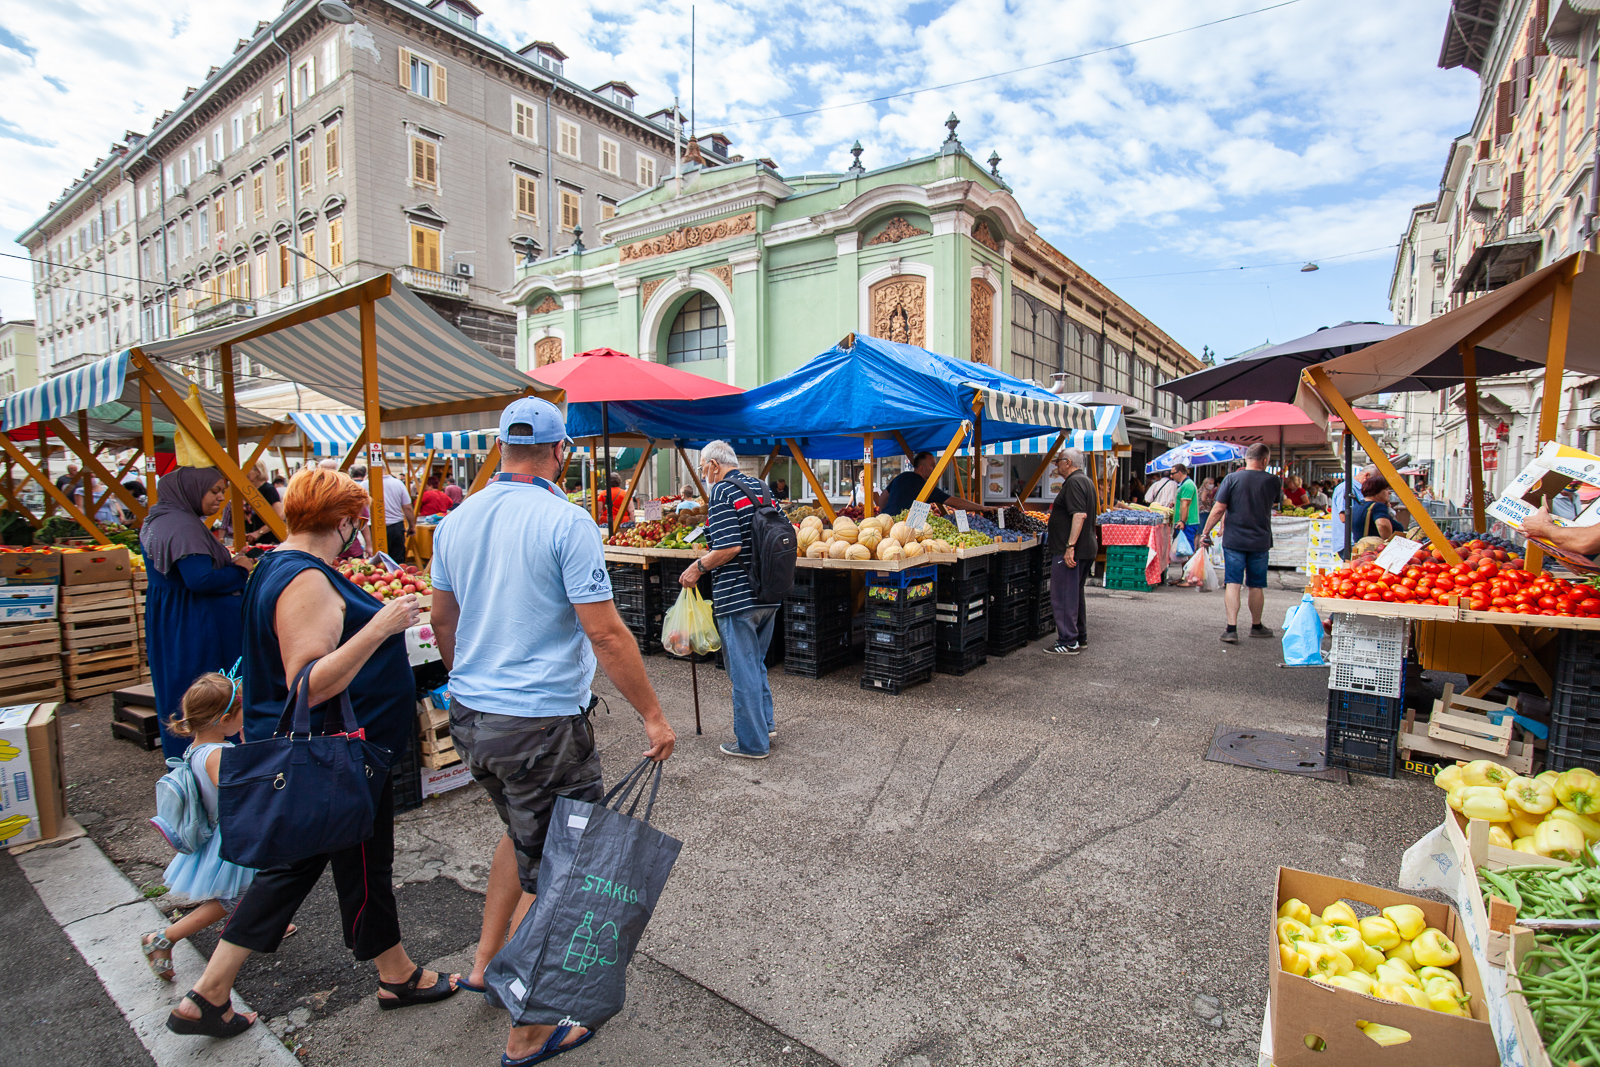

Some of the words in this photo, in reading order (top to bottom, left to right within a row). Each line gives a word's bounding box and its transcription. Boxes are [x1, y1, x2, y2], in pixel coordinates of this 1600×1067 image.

[1004, 405, 1033, 420] ZAMET
[1556, 465, 1587, 479] ECUADOR
[1495, 503, 1524, 523] PREMIUM
[1501, 496, 1531, 516] BANANAS
[428, 772, 451, 784] Maria
[581, 874, 638, 905] STAKLO
